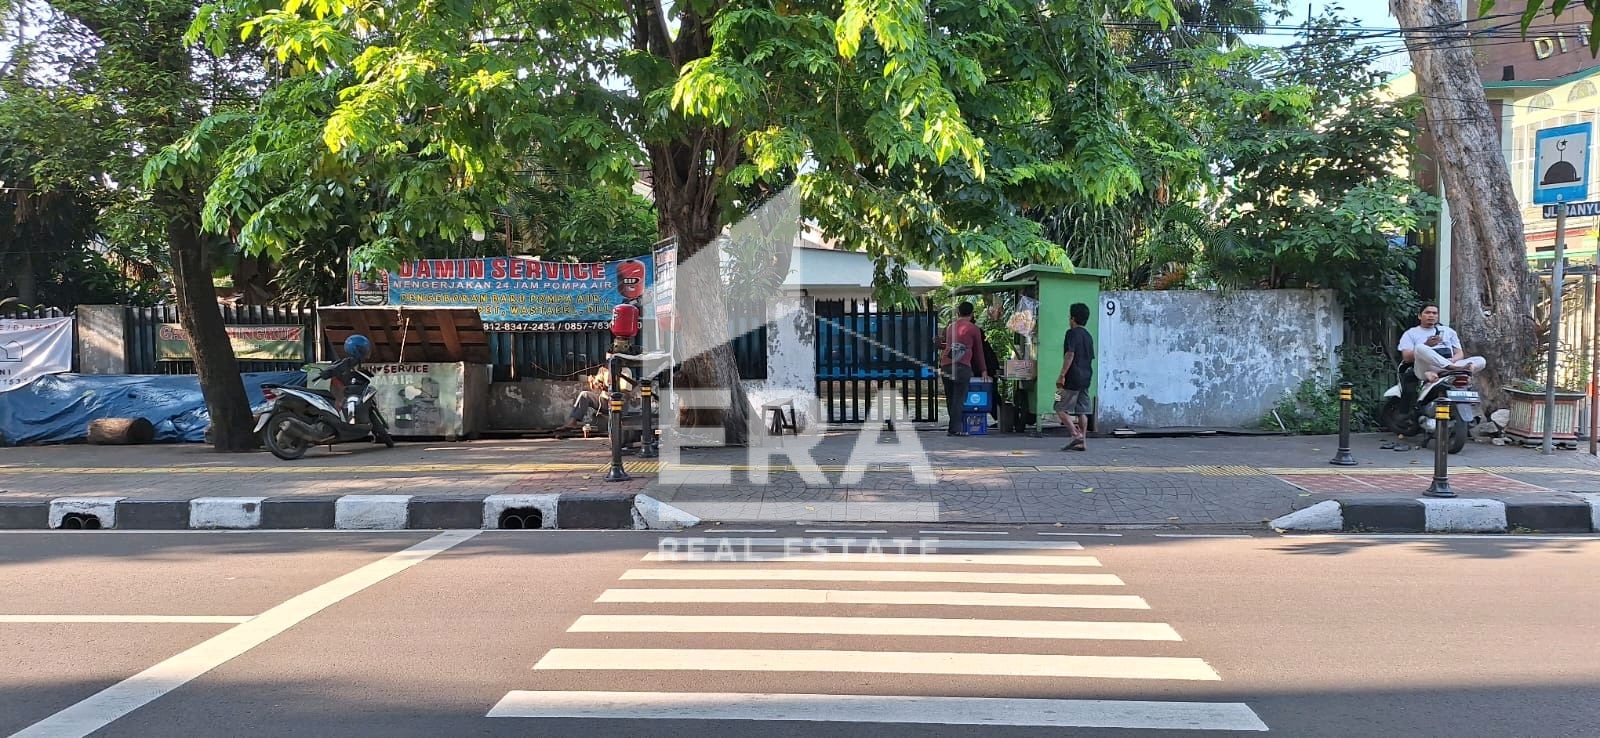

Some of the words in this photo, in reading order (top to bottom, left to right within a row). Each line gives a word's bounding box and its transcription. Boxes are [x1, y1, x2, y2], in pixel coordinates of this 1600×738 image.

[399, 259, 485, 280] DAMIN
[491, 258, 606, 281] SERVICE
[393, 280, 491, 289] MENGERJAKAN
[496, 281, 509, 289] 24
[513, 281, 539, 290] JAM
[543, 281, 587, 290] POMPA
[591, 281, 612, 289] AIR
[402, 292, 488, 302] PENGEBORAN
[492, 293, 525, 303] BARU
[529, 293, 572, 304] POMPA
[1106, 300, 1116, 316] 9
[384, 364, 429, 374] SERVICE
[391, 374, 414, 385] AIR
